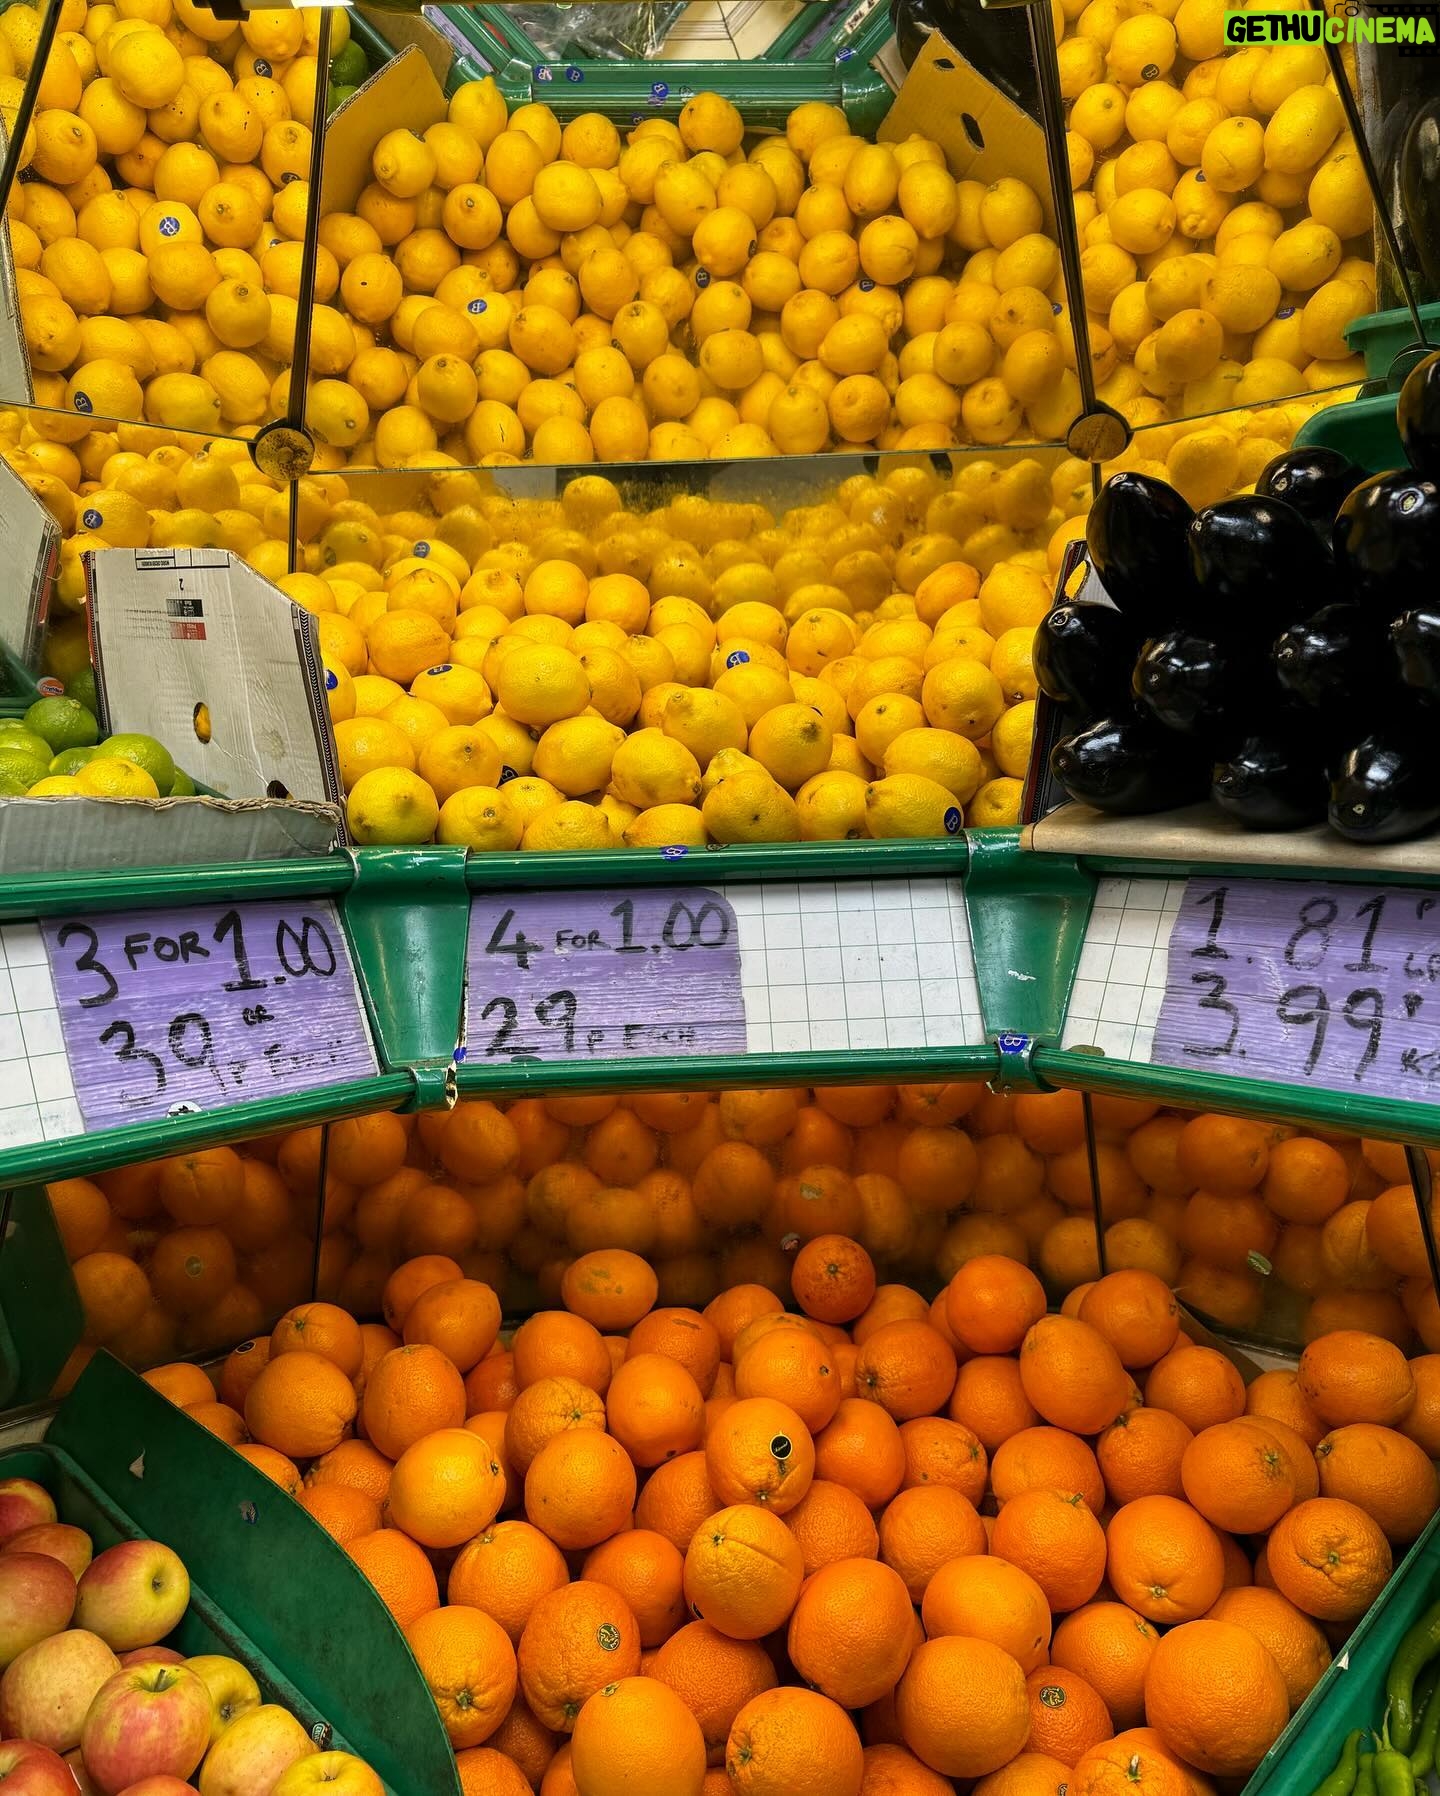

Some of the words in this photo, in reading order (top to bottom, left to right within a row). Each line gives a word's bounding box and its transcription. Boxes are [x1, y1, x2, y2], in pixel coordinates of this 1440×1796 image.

[57, 921, 119, 1009] 3
[123, 930, 210, 971] FOR
[213, 909, 337, 992] 1.00
[485, 908, 544, 970] 4
[556, 928, 611, 951] FOR
[610, 899, 730, 954] 1.00
[1190, 886, 1388, 971] 1.81
[1182, 970, 1385, 1082] 3.99
